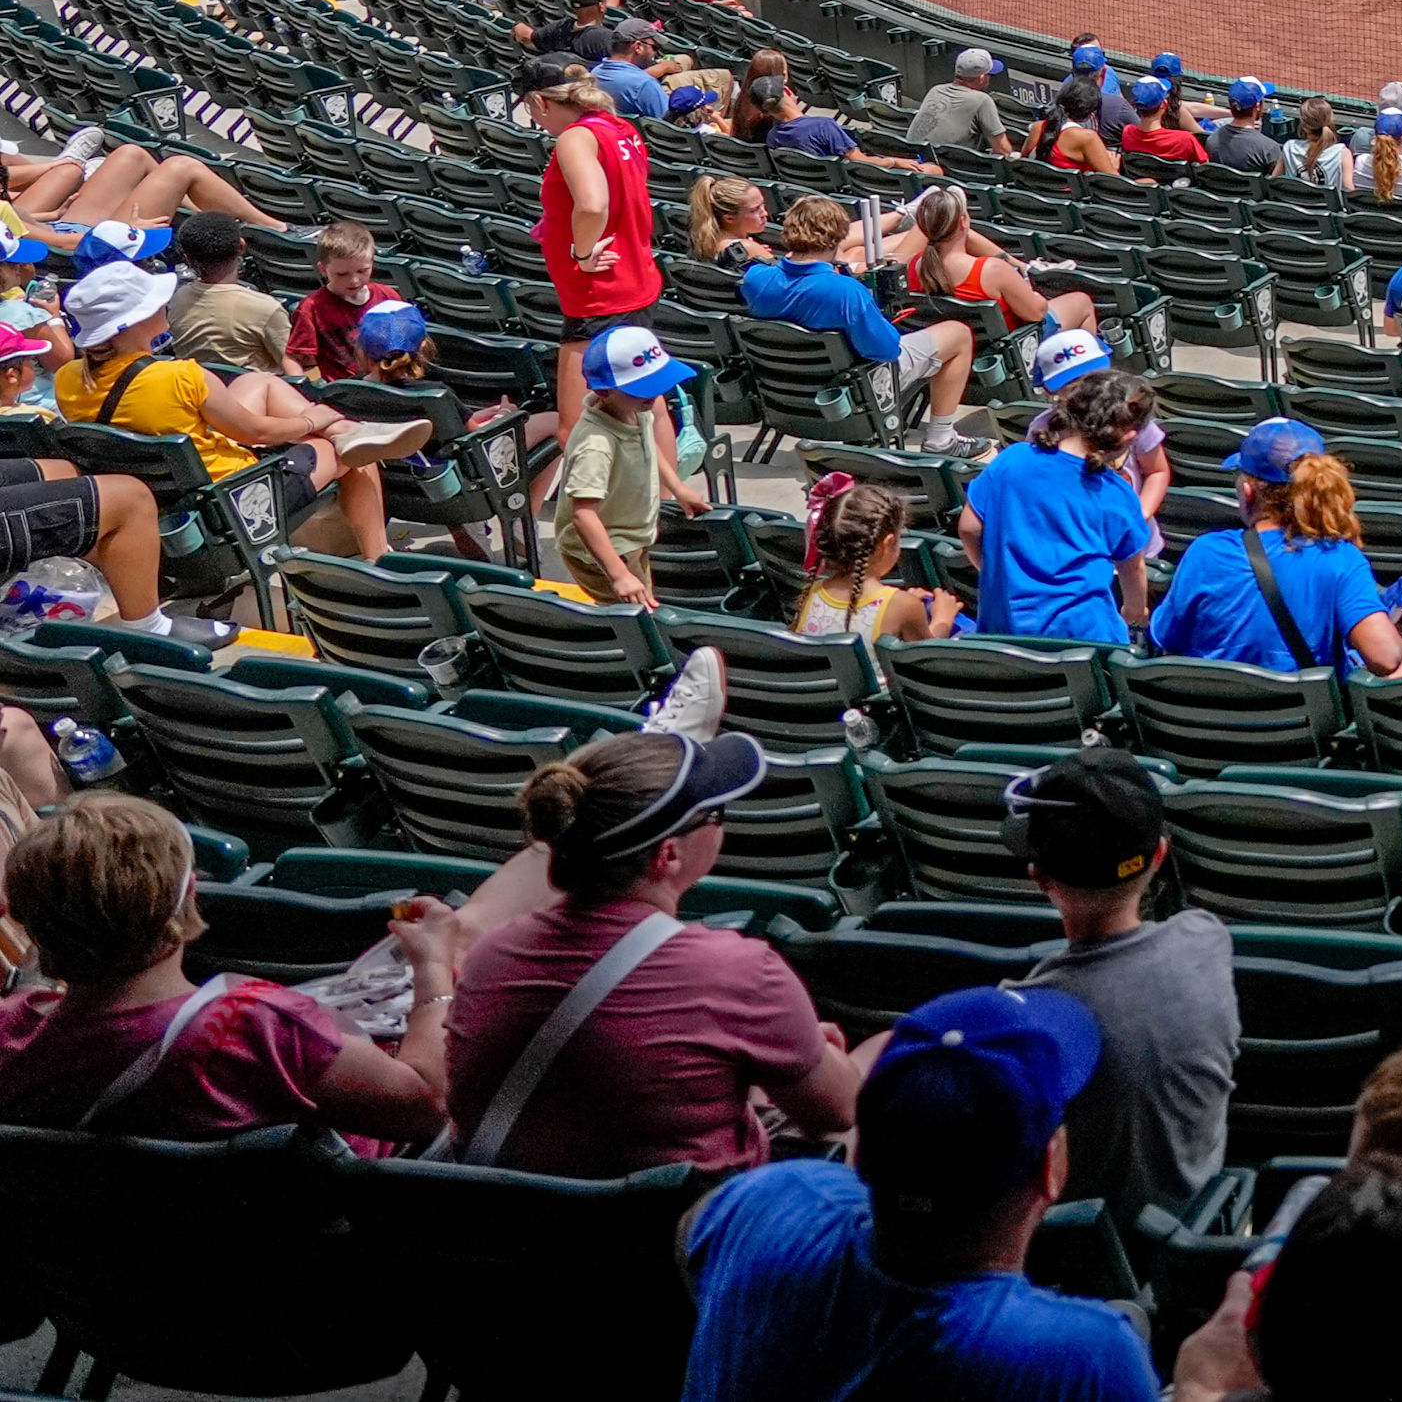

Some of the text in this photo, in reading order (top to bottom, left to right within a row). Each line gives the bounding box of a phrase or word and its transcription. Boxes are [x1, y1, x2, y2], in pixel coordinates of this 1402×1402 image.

[1019, 88, 1035, 103] 108
[632, 346, 662, 367] OKC
[1053, 344, 1086, 365] OKC
